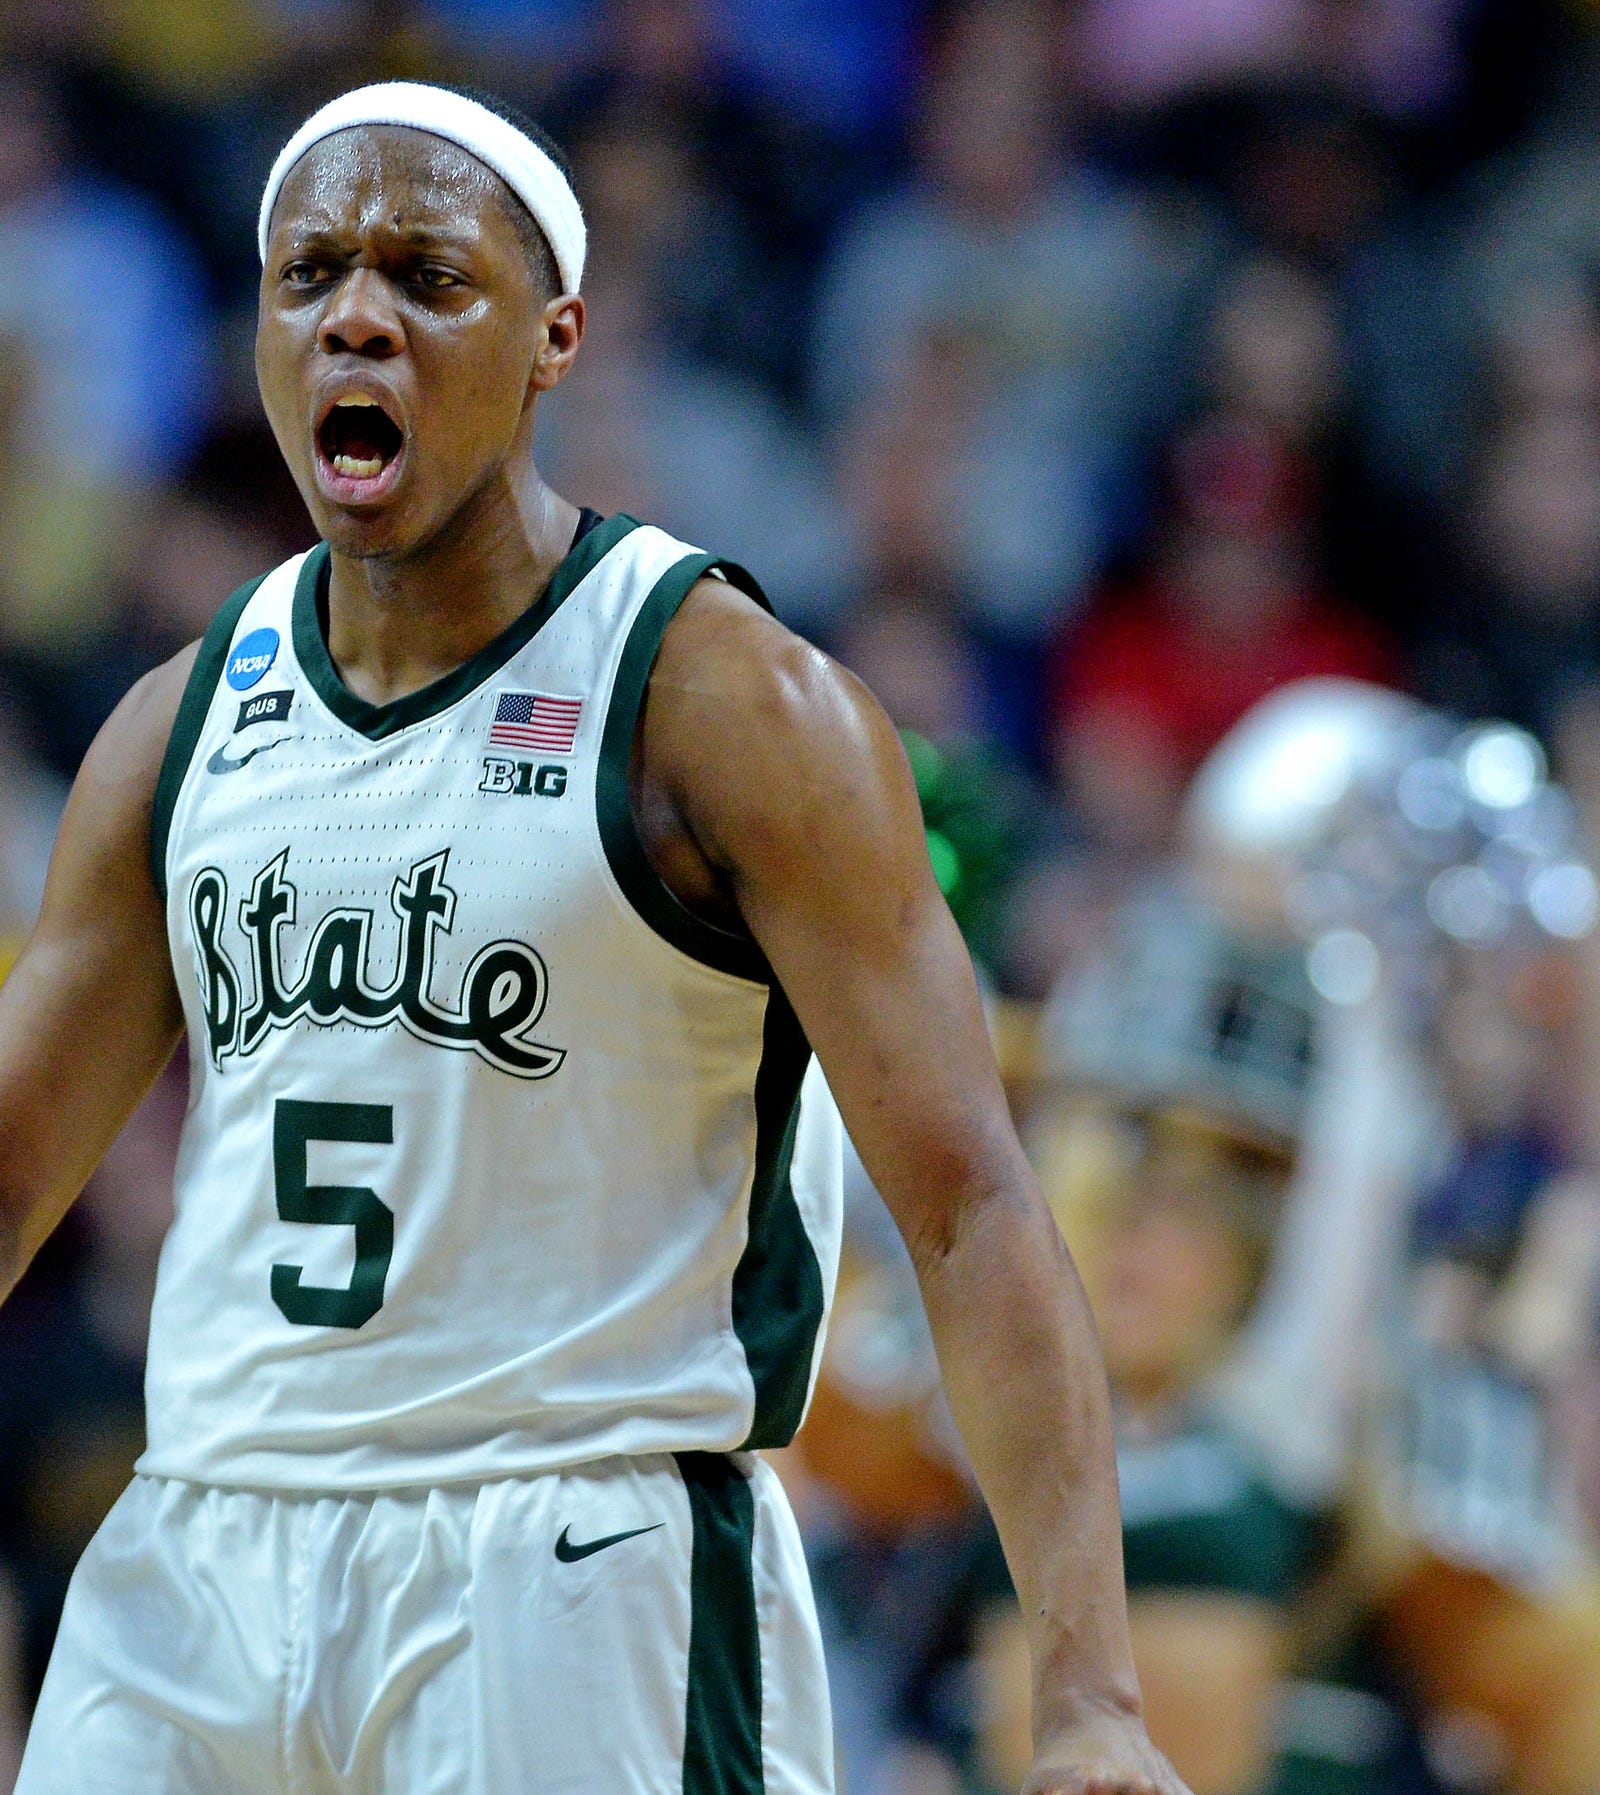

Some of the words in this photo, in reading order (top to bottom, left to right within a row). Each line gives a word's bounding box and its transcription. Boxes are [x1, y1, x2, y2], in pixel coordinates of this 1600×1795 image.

[230, 654, 271, 675] NCAA
[189, 845, 568, 1080] State
[270, 1098, 395, 1330] 5
